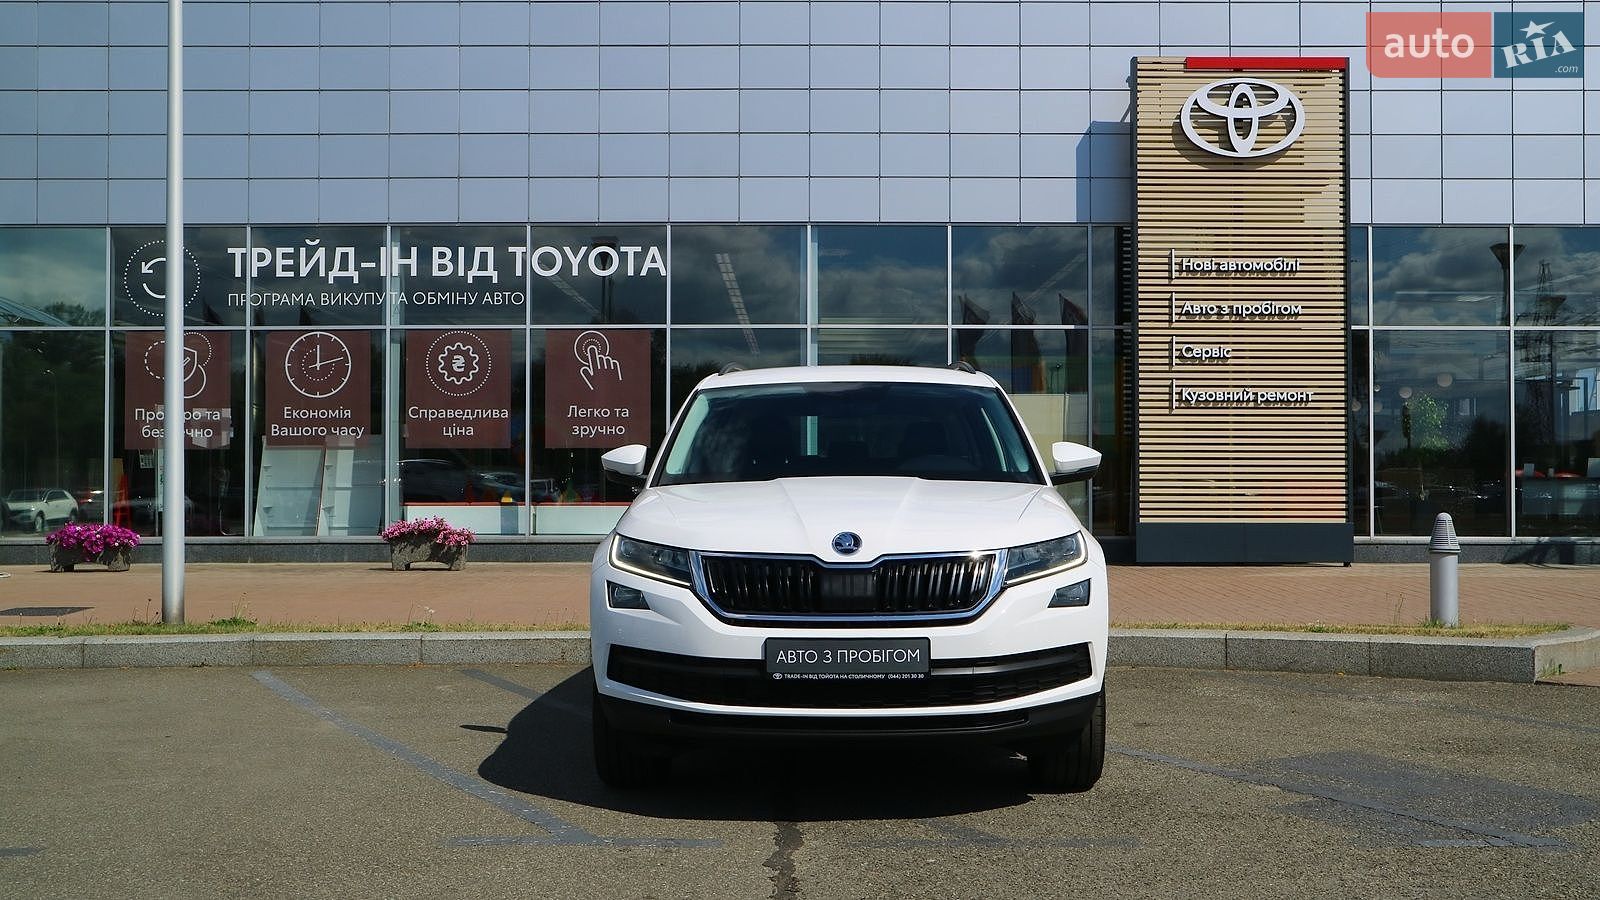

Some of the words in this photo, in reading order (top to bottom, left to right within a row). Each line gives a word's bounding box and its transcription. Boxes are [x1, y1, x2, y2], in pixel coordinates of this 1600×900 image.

[228, 239, 417, 284] ТРЕЙД-ІН
[432, 246, 498, 284] ВІД
[1182, 258, 1216, 271] Нові
[1219, 257, 1300, 271] автомобілі
[228, 293, 315, 306] ПРОГРАМА
[320, 292, 386, 305] ВИКУПУ
[389, 292, 408, 305] ТА
[412, 291, 479, 305] ОБМІНУ
[483, 291, 526, 305] АВТО
[1182, 302, 1217, 315] Авто
[1220, 305, 1228, 315] з
[1233, 301, 1302, 317] пробігом
[1182, 345, 1232, 360] Сервіс
[1182, 388, 1253, 404] Кузовний
[1258, 392, 1314, 404] ремонт
[205, 411, 220, 420] та
[284, 406, 351, 419] Економія
[408, 406, 509, 422] Справедлива
[568, 405, 610, 418] Легко
[613, 408, 629, 418] та
[271, 423, 327, 437] Вашого
[331, 426, 365, 440] часу
[443, 424, 474, 438] ціна
[572, 425, 626, 438] зручно
[776, 650, 818, 663] АВТО
[837, 649, 920, 663] ПРОБІГОМ
